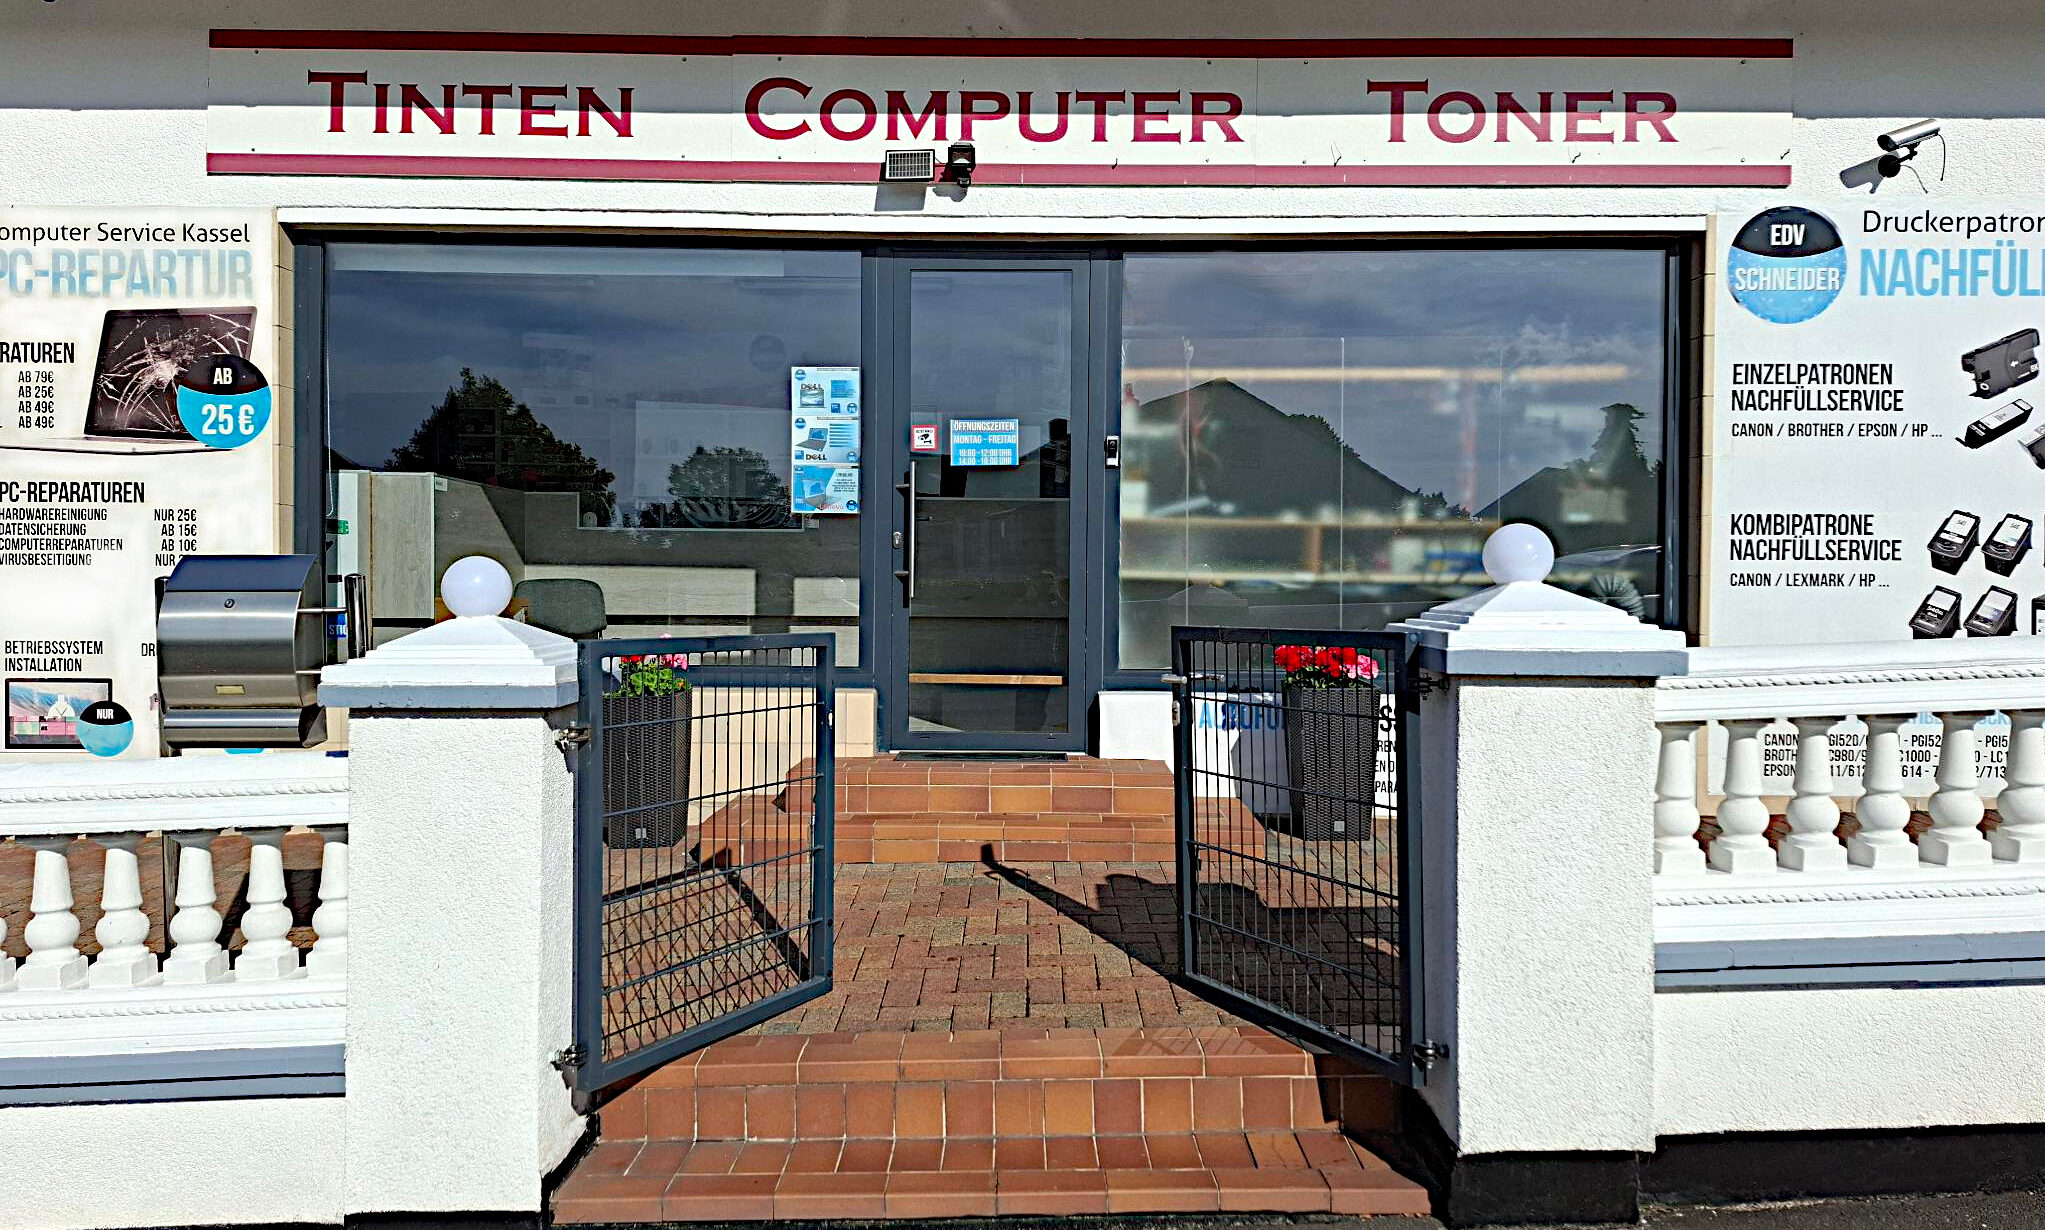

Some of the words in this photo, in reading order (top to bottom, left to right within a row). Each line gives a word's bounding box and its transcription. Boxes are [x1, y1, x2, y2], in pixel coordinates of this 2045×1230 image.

[307, 69, 635, 139] TINTEN
[744, 76, 1244, 144] COMPUTER
[1366, 77, 1680, 144] TONER
[0, 222, 91, 247] omputer
[97, 222, 175, 243] Service
[182, 222, 251, 243] Kassel
[1770, 224, 1805, 246] EDV
[1860, 239, 2045, 297] NACHFÜL
[1735, 266, 1841, 292] SCHNEIDER
[18, 370, 31, 382] AB
[34, 370, 54, 383] 79€
[213, 367, 233, 385] AB
[1733, 363, 1892, 385] EINZELPATRONEN
[18, 386, 31, 398] AB
[34, 386, 54, 399] 25€
[1731, 385, 1903, 412] NACHFÜLLSERVICE
[18, 400, 31, 413] AB
[34, 400, 54, 413] 49€
[18, 415, 31, 428] AB
[34, 415, 54, 428] 49€
[202, 404, 234, 435] 25
[238, 405, 255, 434] €
[954, 420, 1015, 431] ÖFFNUNGSZEITEN
[1732, 423, 1773, 437] CANON
[1788, 423, 1844, 437] BROTHER
[1858, 423, 1897, 437] EPSON
[1912, 423, 1928, 437] HP
[953, 434, 982, 443] MONTAG
[988, 434, 1016, 443] FREITAG
[0, 481, 145, 503] PC-REPARATUREN
[0, 508, 107, 520] HARDWAREREINIGUNG
[154, 509, 175, 521] NUR
[178, 509, 197, 521] 25€
[0, 523, 87, 535] DATENSICHERUNG
[161, 524, 175, 536] AB
[179, 524, 197, 536] 15€
[1730, 514, 1874, 536] KOMBIPATRONE
[0, 538, 123, 551] COMPUTERREPARATUREN
[161, 539, 175, 551] AB
[179, 539, 197, 551] 10€
[1730, 535, 1902, 561] NACHFÜLLSERVICE
[0, 553, 92, 566] VIRUSBESEITIGUNG
[155, 554, 176, 566] NUR
[1730, 573, 1771, 587] CANON
[1786, 573, 1845, 587] LEXMARK
[1859, 573, 1876, 587] HP
[4, 640, 103, 655] BETRIEBSSYSTEM
[141, 643, 157, 657] DR
[4, 657, 82, 672] INSTALLATION
[96, 708, 114, 720] NUR
[1764, 733, 1799, 746] CANON
[1828, 734, 1868, 747] GI520/
